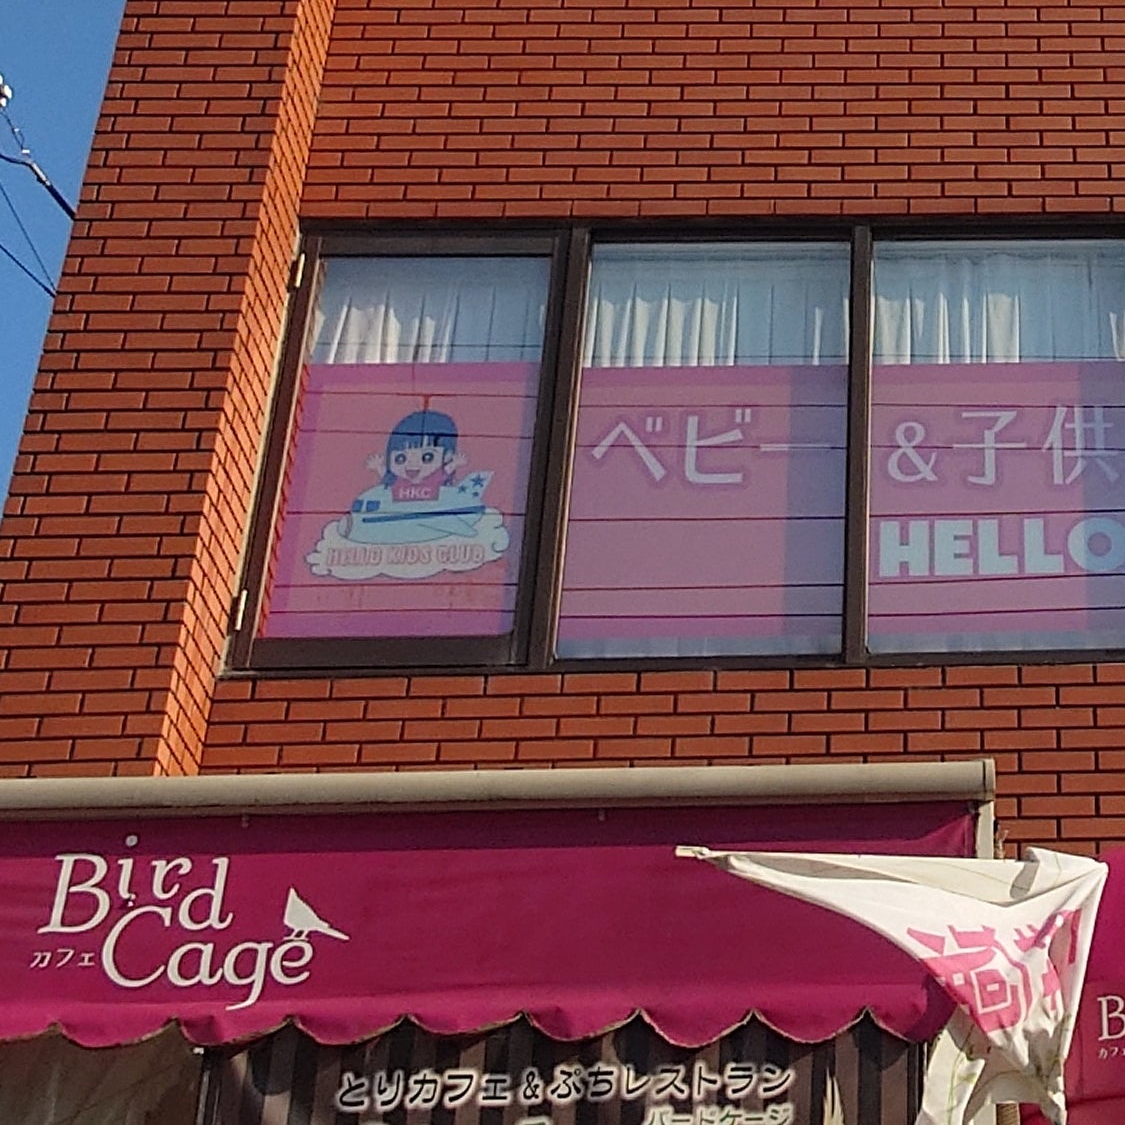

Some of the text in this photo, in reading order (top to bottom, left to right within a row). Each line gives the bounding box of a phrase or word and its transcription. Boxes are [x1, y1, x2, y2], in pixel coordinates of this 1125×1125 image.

[398, 486, 432, 499] HKC
[387, 543, 434, 566] KIDS
[436, 542, 487, 565] CLUB
[37, 834, 234, 934] Bird
[30, 948, 96, 969] カフェ
[102, 905, 314, 1012] Cage
